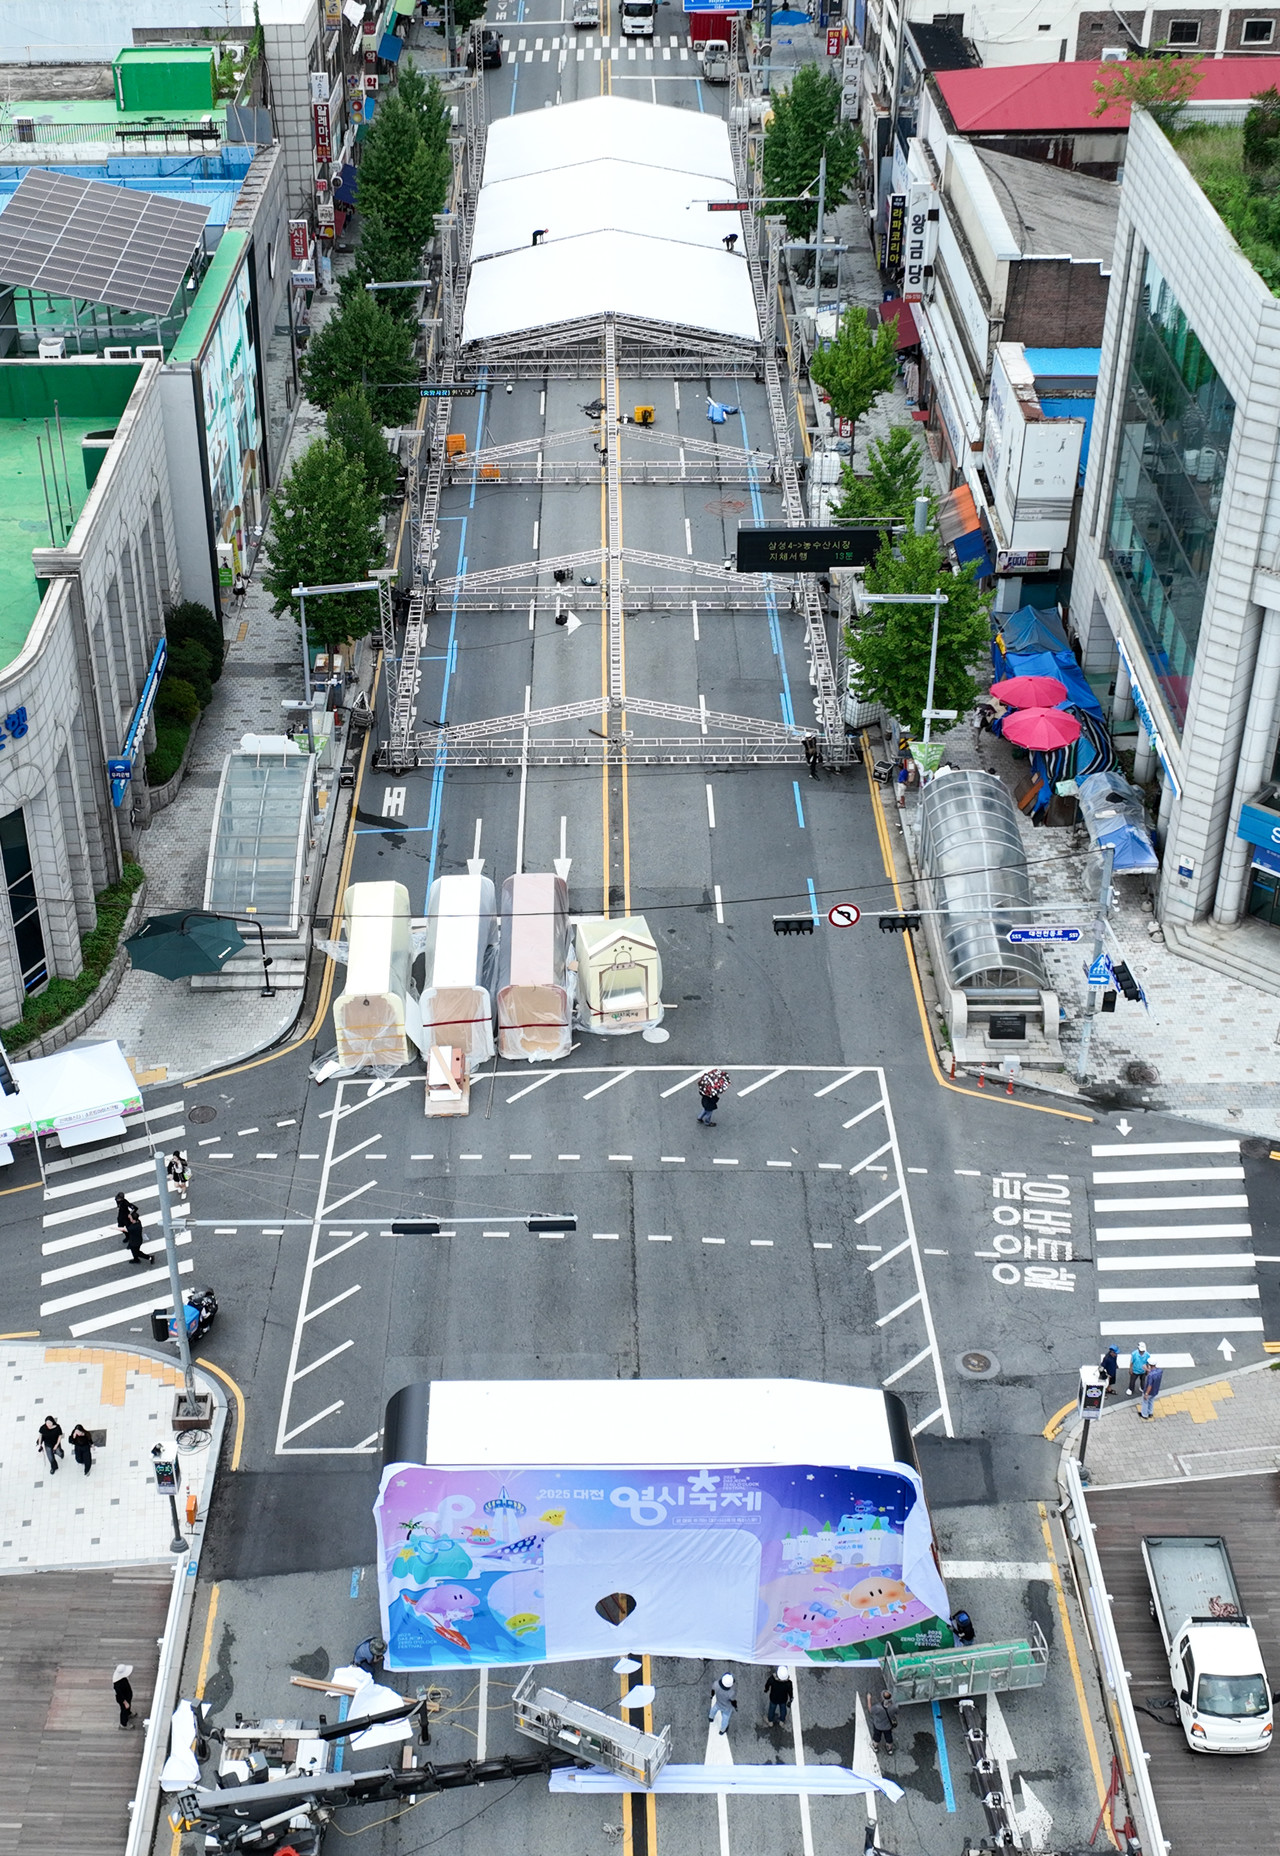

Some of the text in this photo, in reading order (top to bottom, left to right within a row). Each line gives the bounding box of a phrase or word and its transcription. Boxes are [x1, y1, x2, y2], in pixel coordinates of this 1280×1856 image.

[367, 77, 377, 89] 약
[293, 230, 305, 256] 사진관
[889, 208, 904, 264] 라파코리아
[908, 213, 926, 285] 왕금당
[769, 552, 808, 561] 지체서행
[539, 1489, 571, 1500] 2025
[573, 1489, 605, 1500] 대전
[609, 1469, 762, 1527] 영시축제
